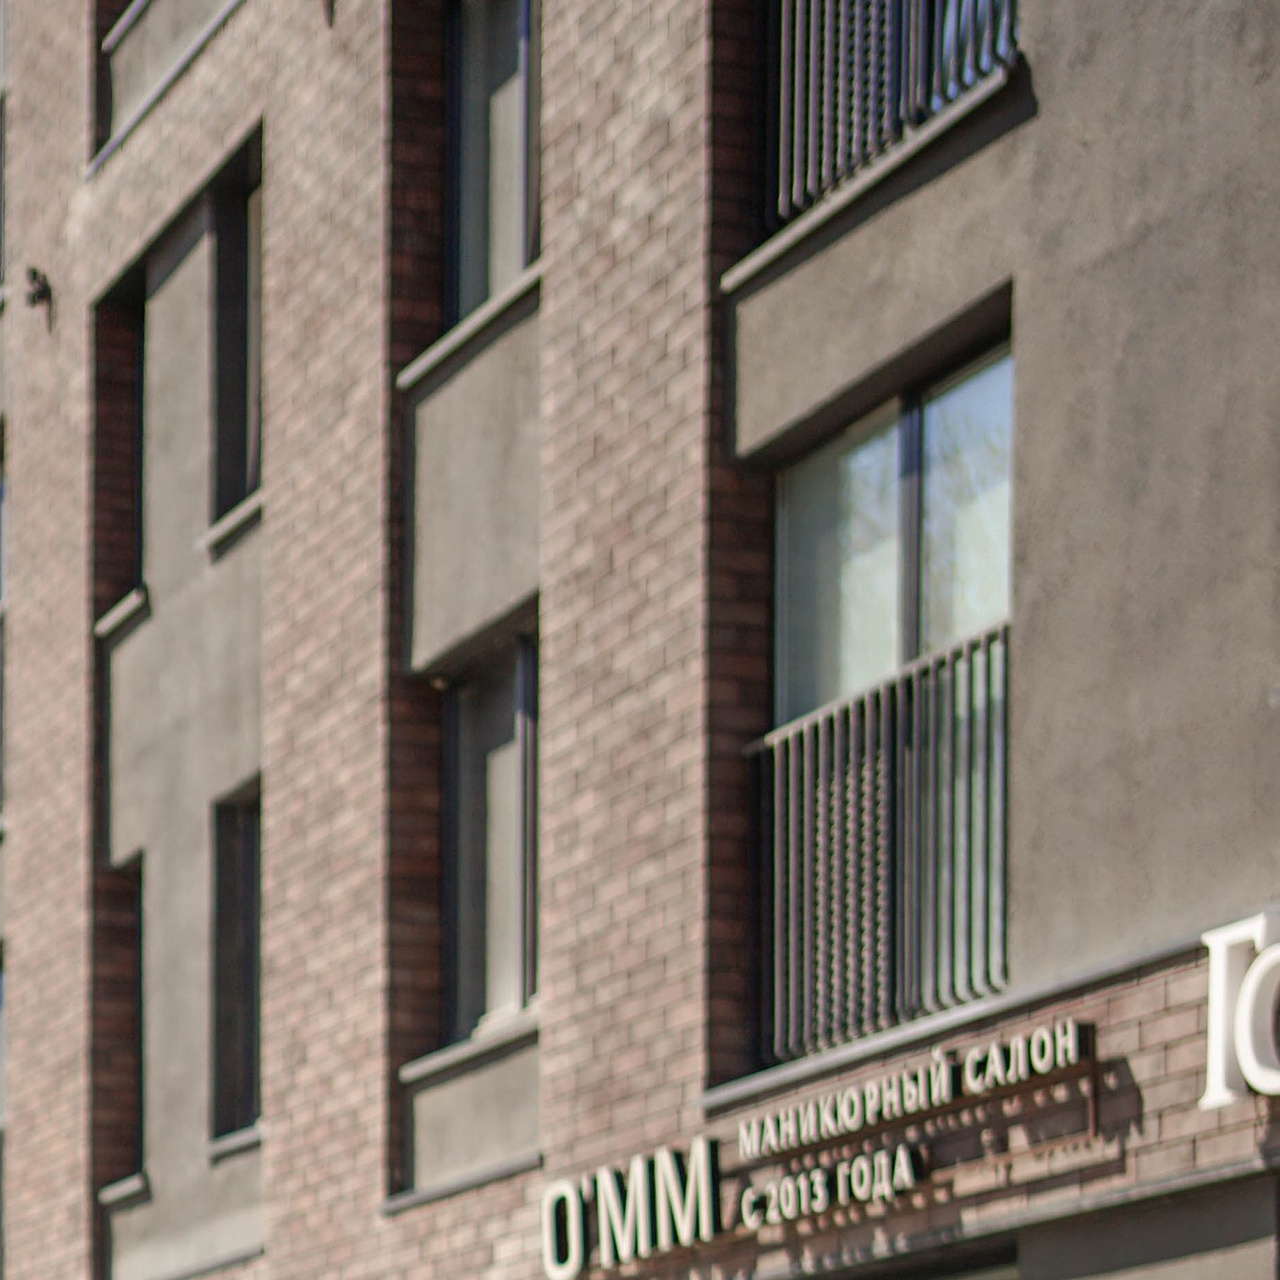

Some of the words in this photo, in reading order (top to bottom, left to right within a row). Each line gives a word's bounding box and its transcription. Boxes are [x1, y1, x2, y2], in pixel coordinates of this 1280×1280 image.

[738, 1046, 954, 1160] МАНИКЮРНЫЙ
[964, 1015, 1079, 1095] САЛОН
[741, 1186, 764, 1231] С
[765, 1167, 829, 1224] 2013
[837, 1143, 916, 1206] ГОДА
